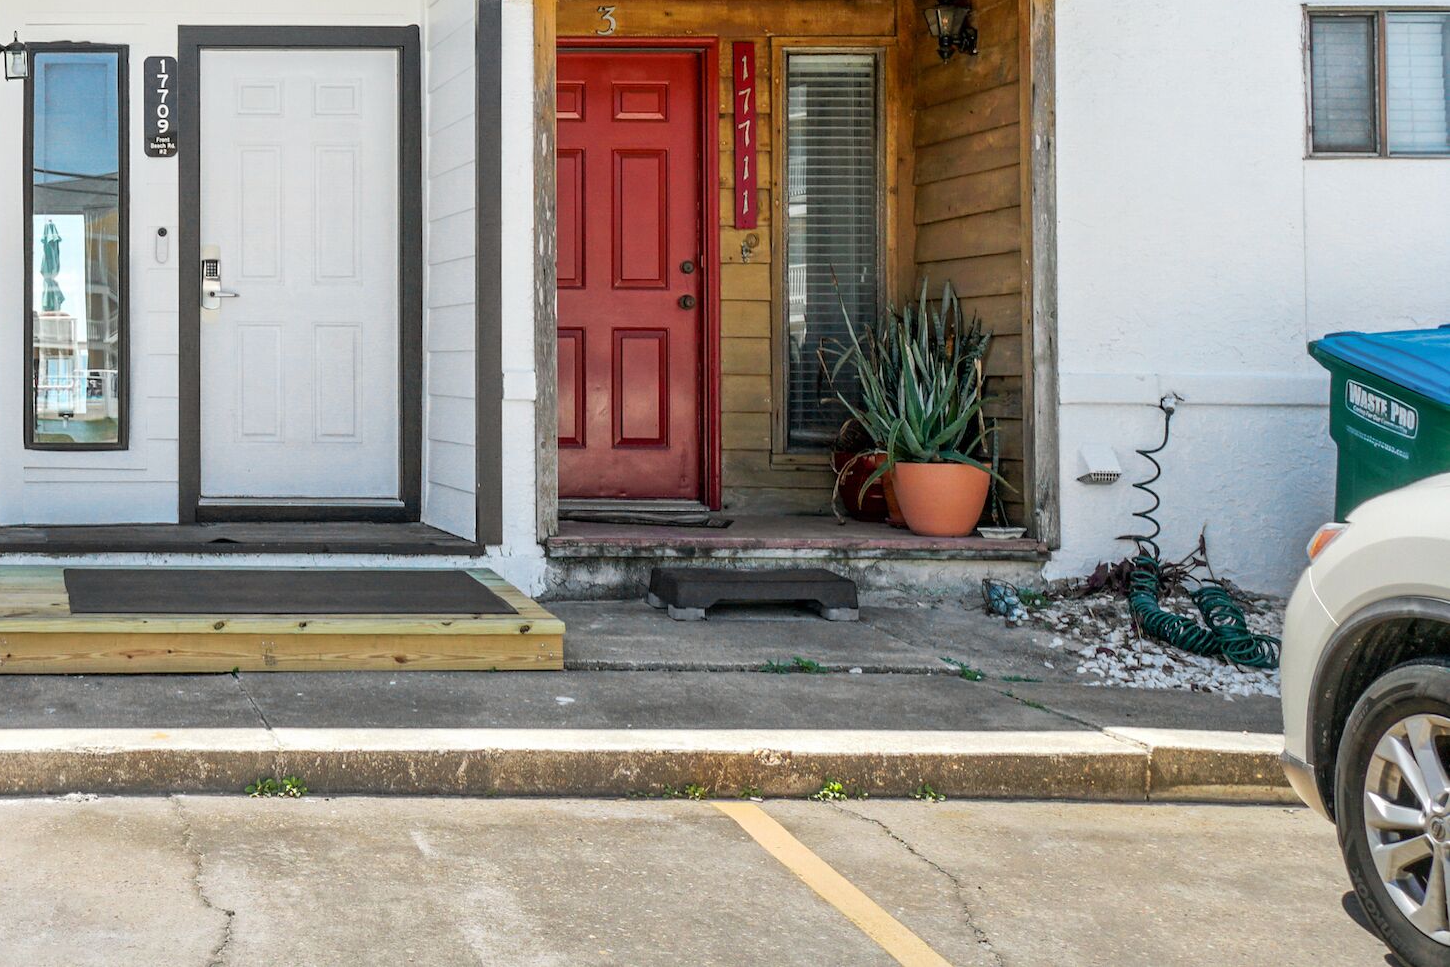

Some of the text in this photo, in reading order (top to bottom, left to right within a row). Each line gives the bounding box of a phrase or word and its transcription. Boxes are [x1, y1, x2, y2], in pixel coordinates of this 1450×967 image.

[596, 5, 617, 36] 3
[157, 59, 169, 134] 17709
[738, 55, 752, 215] 17711
[1348, 382, 1388, 415] WASTE
[1390, 400, 1416, 431] PRO
